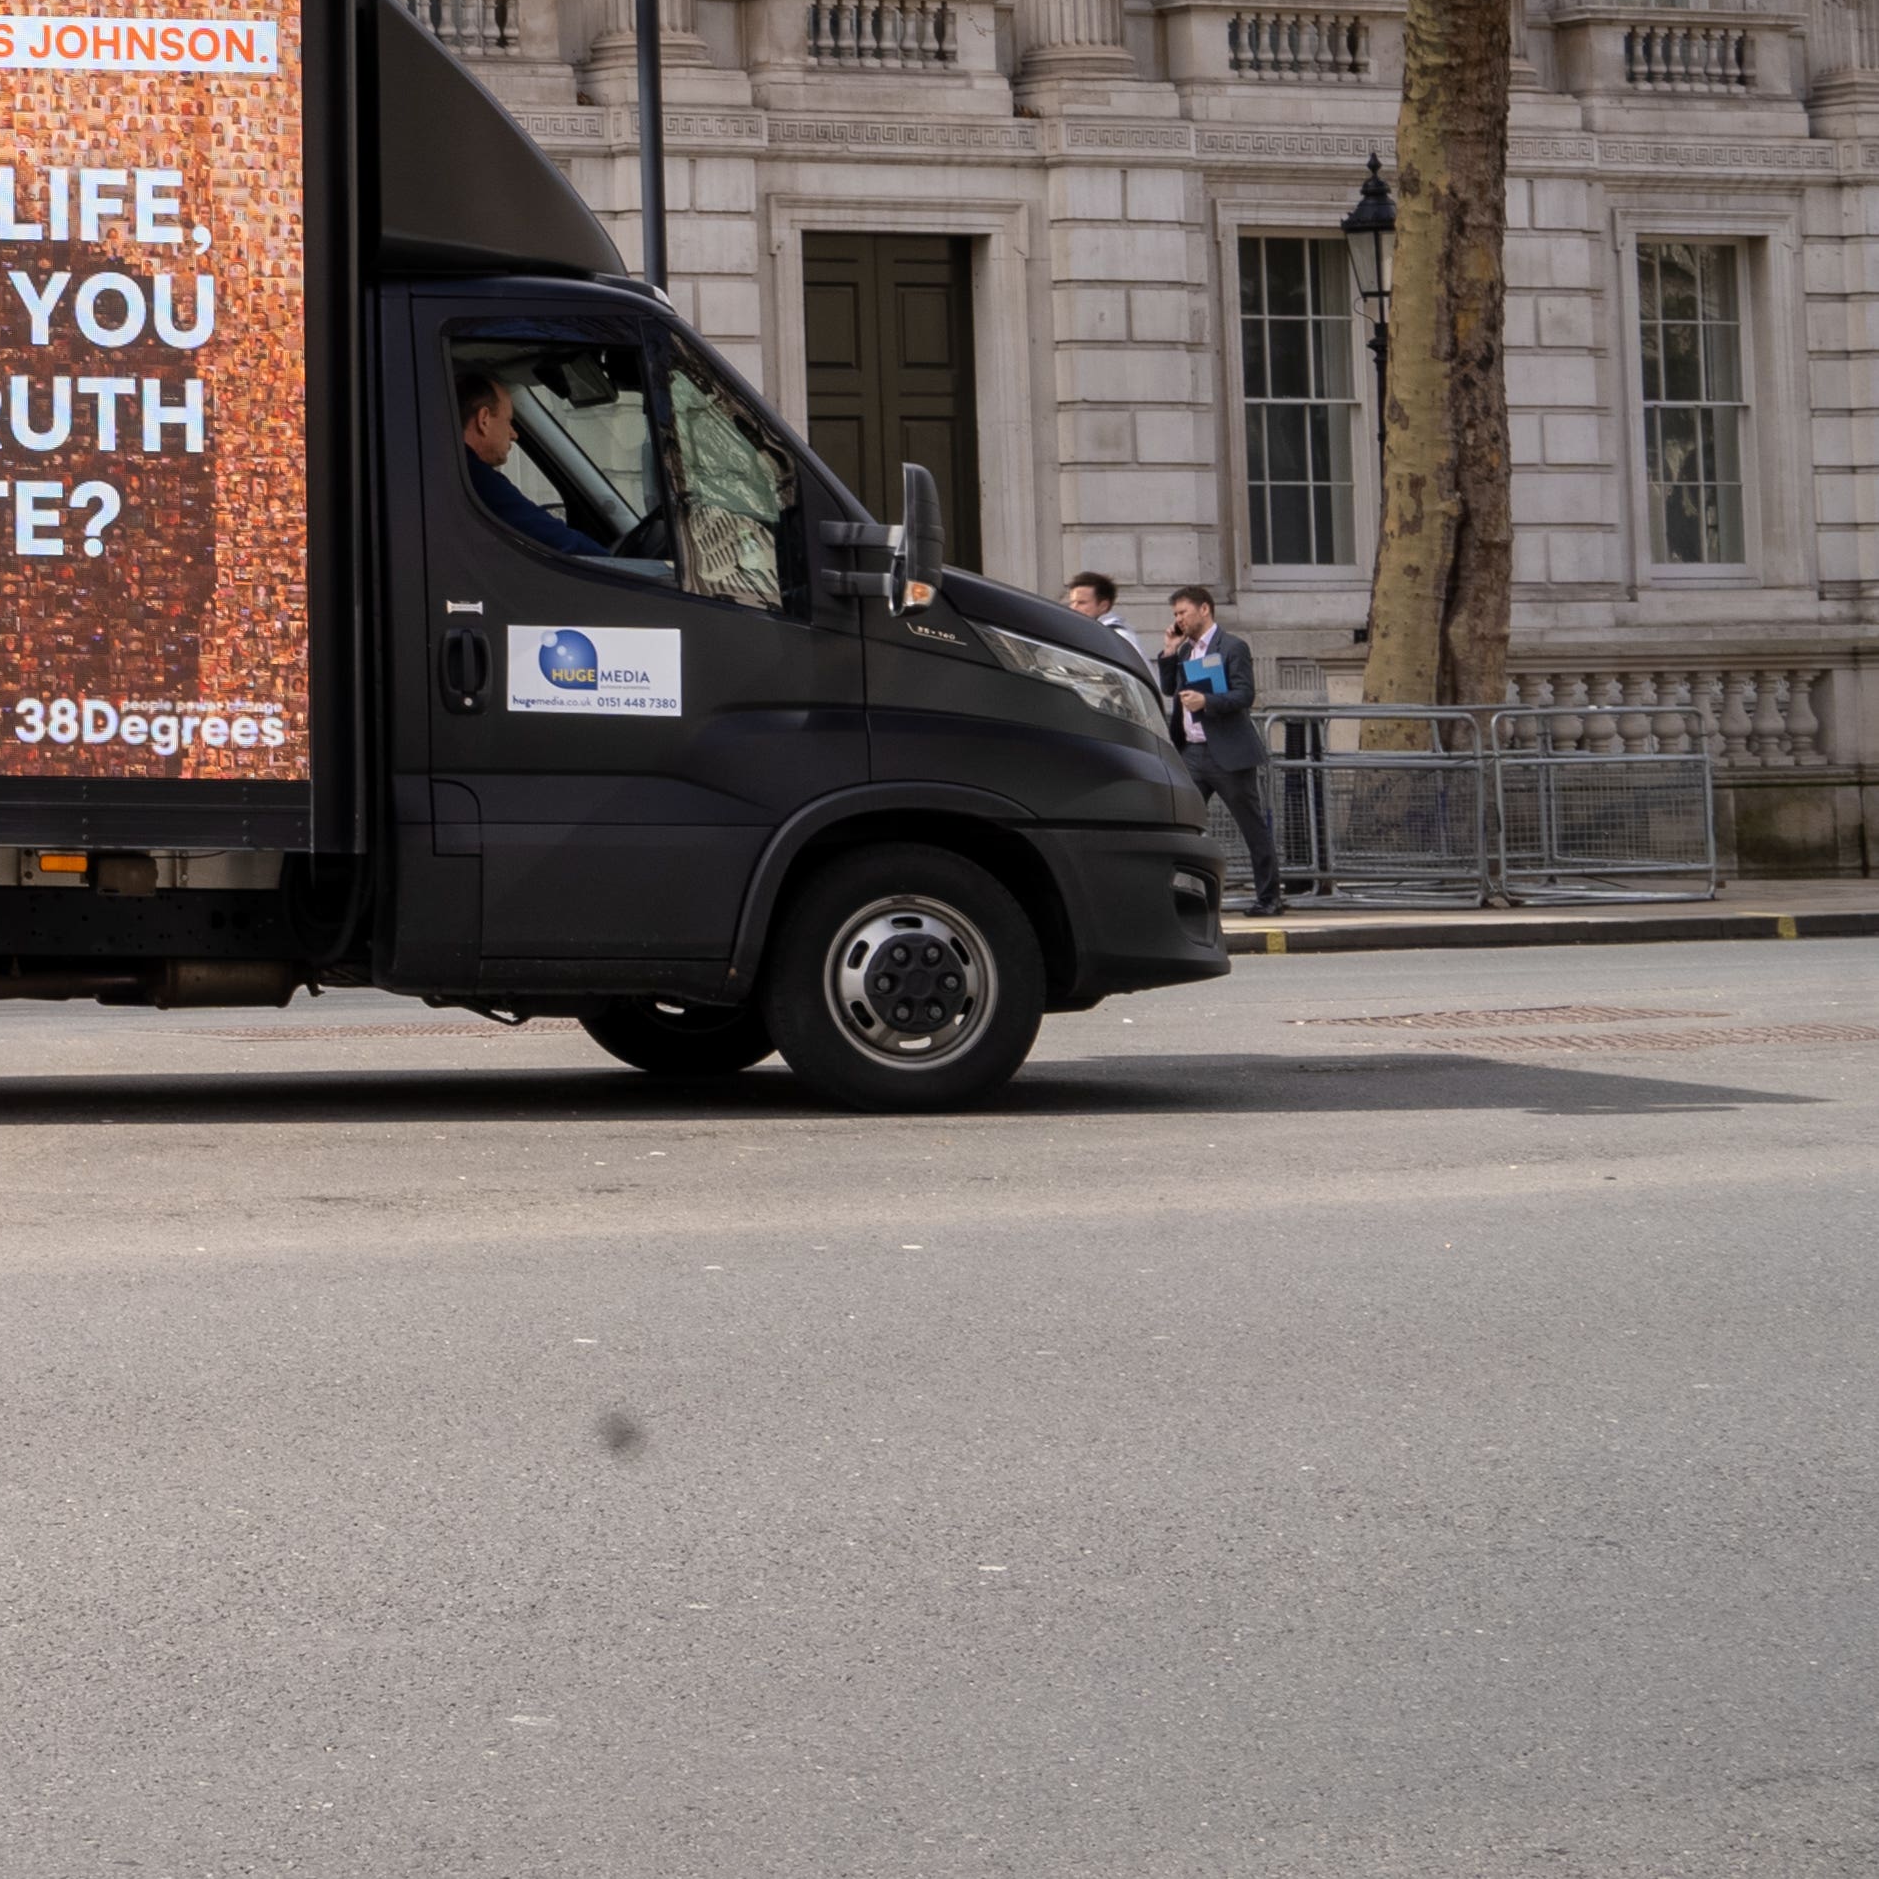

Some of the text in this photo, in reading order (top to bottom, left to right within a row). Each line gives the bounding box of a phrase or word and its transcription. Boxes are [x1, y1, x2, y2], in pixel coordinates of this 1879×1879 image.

[28, 24, 270, 64] JOHNSON.
[8, 270, 216, 349] YOU
[551, 668, 651, 683] HUGE MEDIA
[512, 695, 677, 709] hugemedia.co.uk 0151 448 7380
[14, 697, 286, 757] 38Degrees
